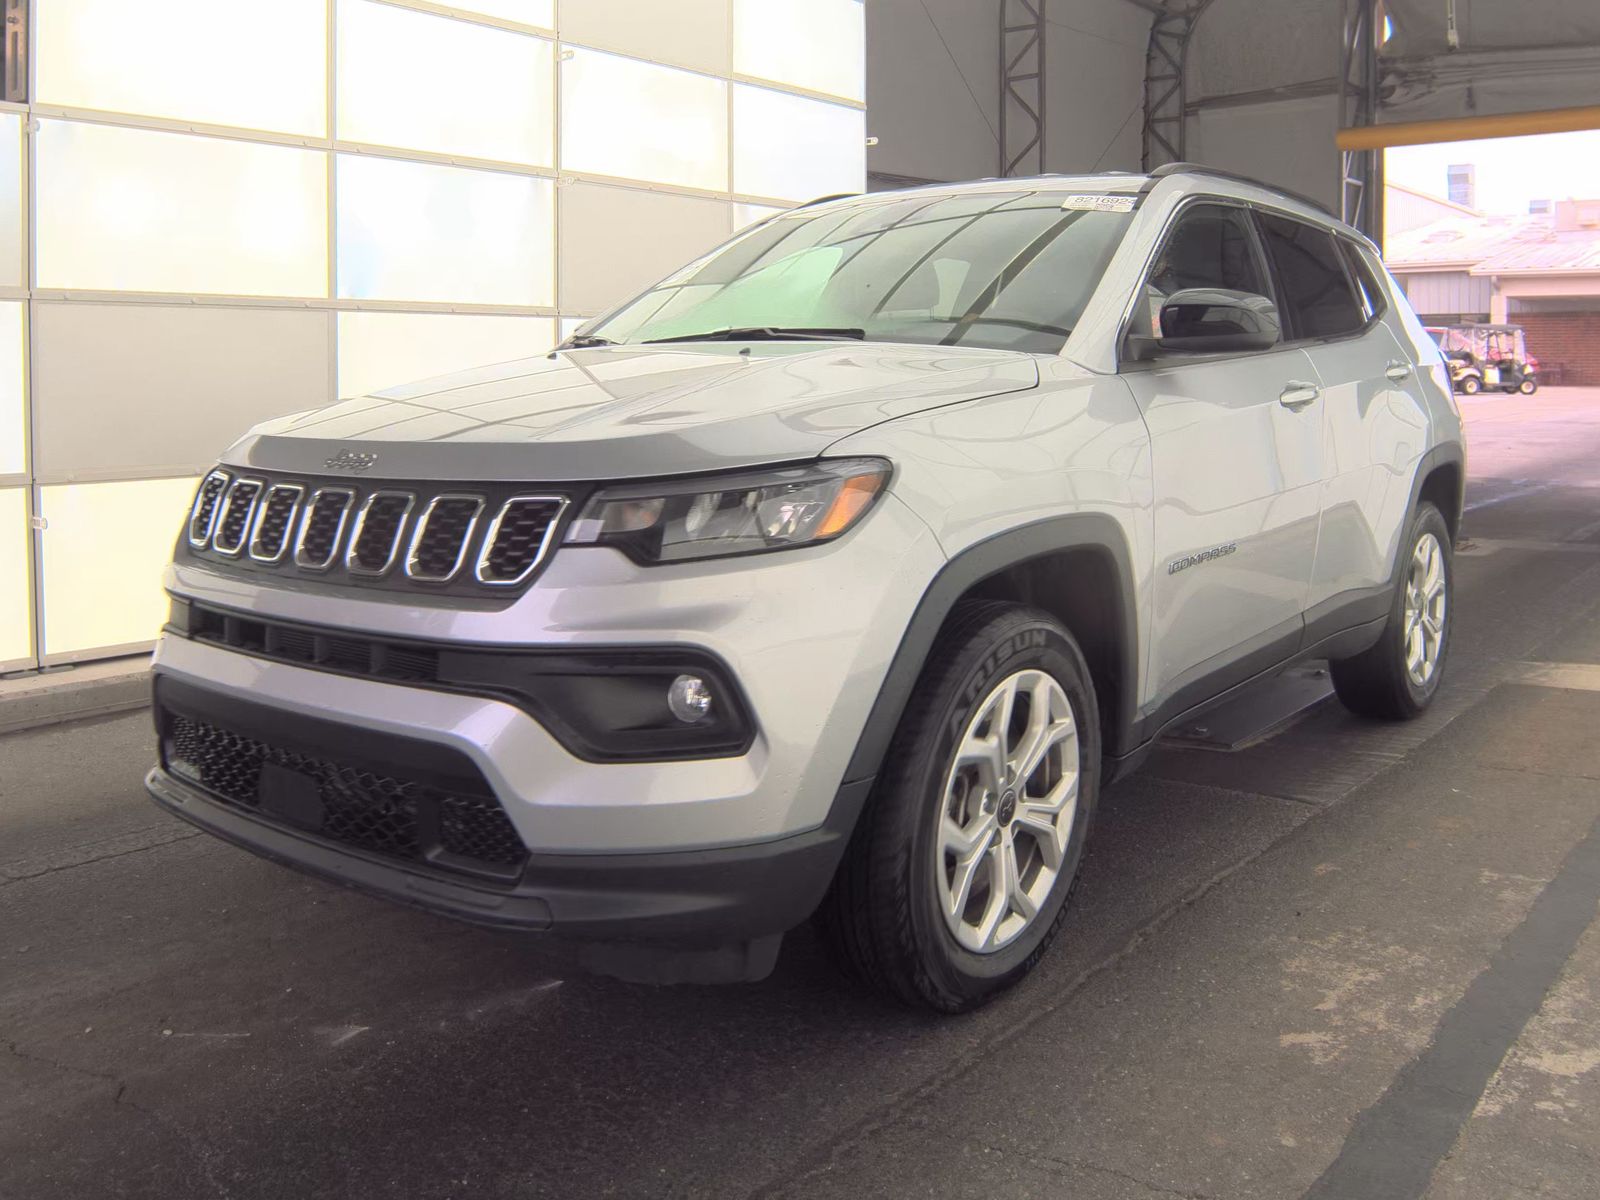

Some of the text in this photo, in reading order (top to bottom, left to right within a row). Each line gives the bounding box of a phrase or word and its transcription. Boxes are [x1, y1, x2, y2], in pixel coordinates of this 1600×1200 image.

[324, 448, 377, 475] Jeep
[1168, 543, 1237, 575] COMPASS
[949, 629, 1047, 738] ARISUN
